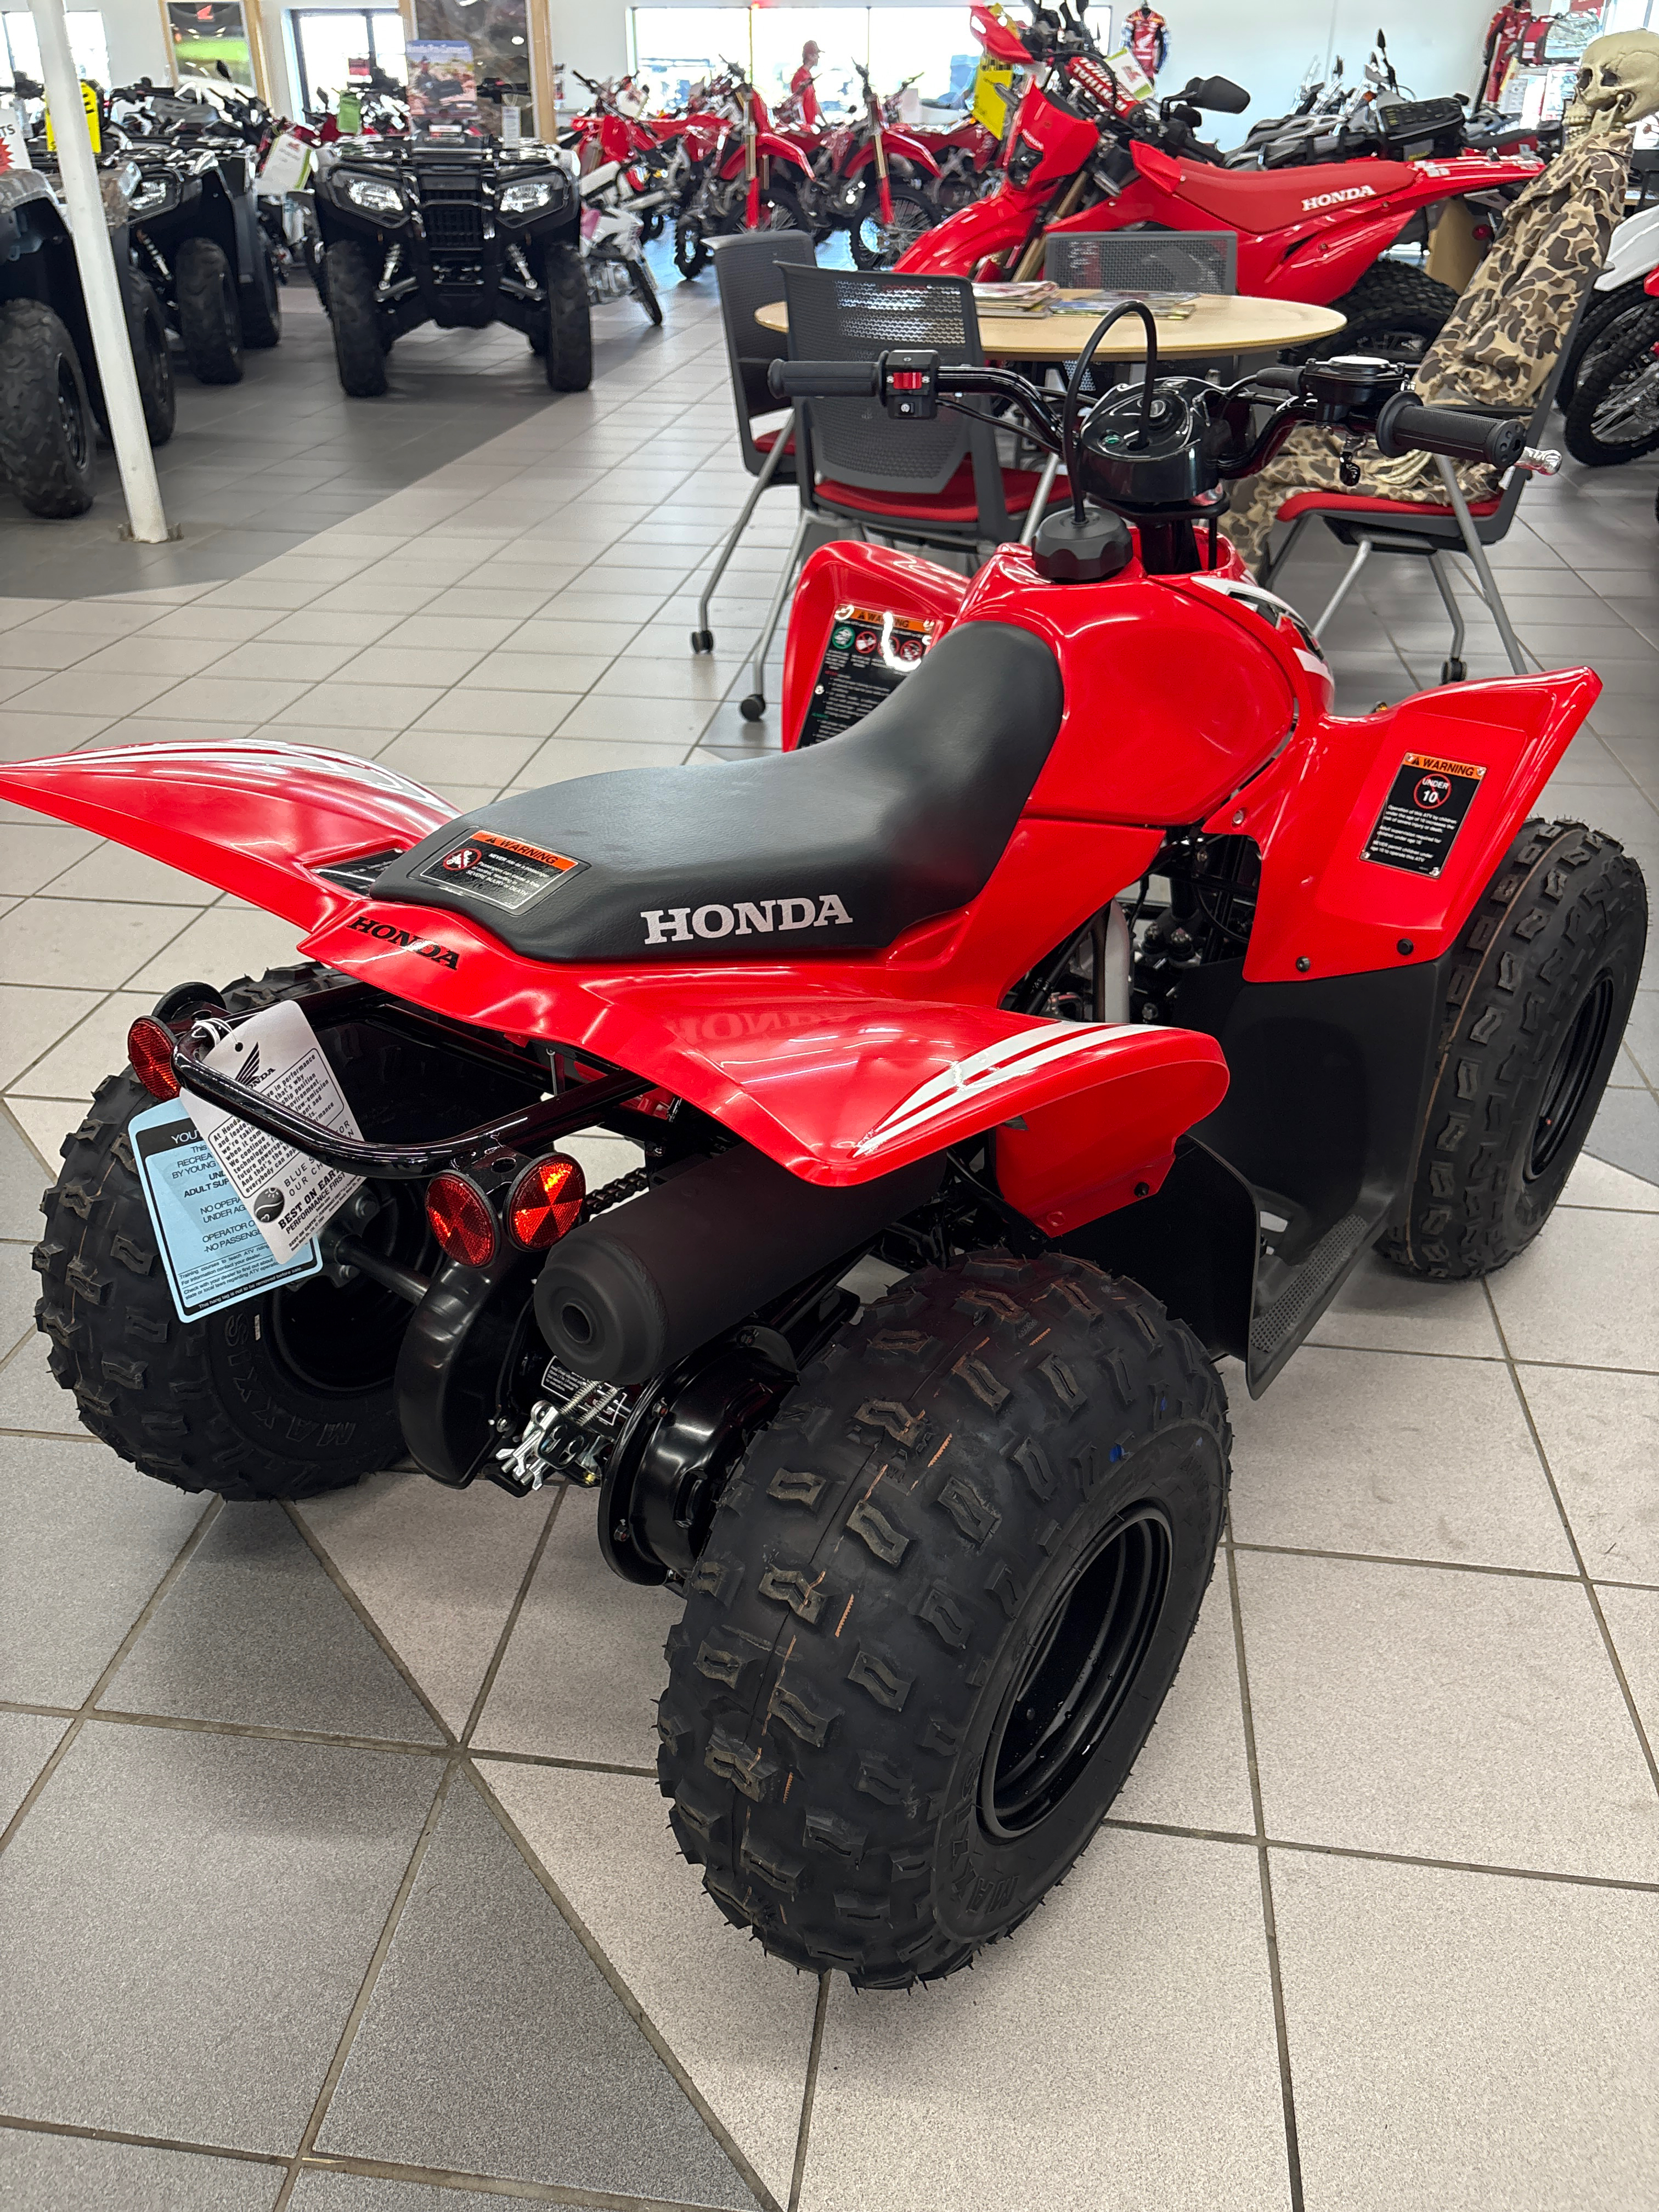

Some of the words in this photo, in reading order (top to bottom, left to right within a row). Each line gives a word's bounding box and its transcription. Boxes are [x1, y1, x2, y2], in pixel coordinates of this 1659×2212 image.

[1073, 63, 1128, 111] RNTHAL
[1301, 185, 1376, 212] HONDA
[1423, 758, 1474, 776] WARNING
[1421, 778, 1448, 790] UNDER
[1423, 790, 1438, 803] 10
[500, 839, 558, 865] WARNING
[488, 853, 507, 861] NEVER
[524, 866, 549, 878] passenger
[466, 870, 487, 879] SEVERE
[485, 877, 505, 885] INJURY
[508, 884, 528, 896] DEATH
[641, 894, 853, 944] HONDA
[347, 916, 459, 970] HONDA
[248, 1068, 276, 1091] ONDA
[213, 1132, 221, 1142] At
[282, 1054, 315, 1085] performance
[217, 1135, 229, 1148] and
[275, 1084, 292, 1100] that's
[293, 1074, 304, 1085] why
[221, 1139, 239, 1154] we're
[294, 1073, 315, 1094] position
[229, 1158, 239, 1167] We
[240, 1136, 265, 1159] continue
[295, 1079, 329, 1111] low-emission
[234, 1142, 270, 1173] technologies
[312, 1094, 321, 1105] and
[190, 1144, 207, 1153] This
[225, 1147, 241, 1160] when
[284, 1163, 307, 1187] BLUE
[335, 1120, 349, 1137] OR
[171, 1169, 183, 1179] BY
[185, 1160, 216, 1174] YOUNG
[237, 1163, 256, 1180] future
[241, 1174, 253, 1187] And
[253, 1159, 272, 1176] that's
[272, 1150, 282, 1160] the
[246, 1167, 273, 1193] everybody
[274, 1157, 285, 1168] can
[184, 1183, 210, 1198] ADULT
[289, 1176, 308, 1196] OUR
[200, 1205, 213, 1215] NO
[278, 1202, 302, 1229] BEST
[304, 1188, 317, 1204] ON
[286, 1190, 329, 1233] PERFORMANCE
[329, 1171, 345, 1190] FIRST
[202, 1208, 232, 1223] UNDER
[202, 1222, 247, 1242] OPERATOR
[204, 1243, 219, 1252] -NO
[179, 1269, 199, 1279] Training
[200, 1262, 219, 1271] courses
[190, 1269, 216, 1282] information
[216, 1262, 234, 1272] contact
[245, 1253, 260, 1261] dealer.
[227, 1272, 249, 1283] regarding
[183, 1286, 199, 1294] Check
[221, 1271, 235, 1279] dealer
[255, 1276, 275, 1286] removed
[224, 1312, 357, 1447] MAXXIS
[951, 1753, 1019, 1915] MAXXIS
